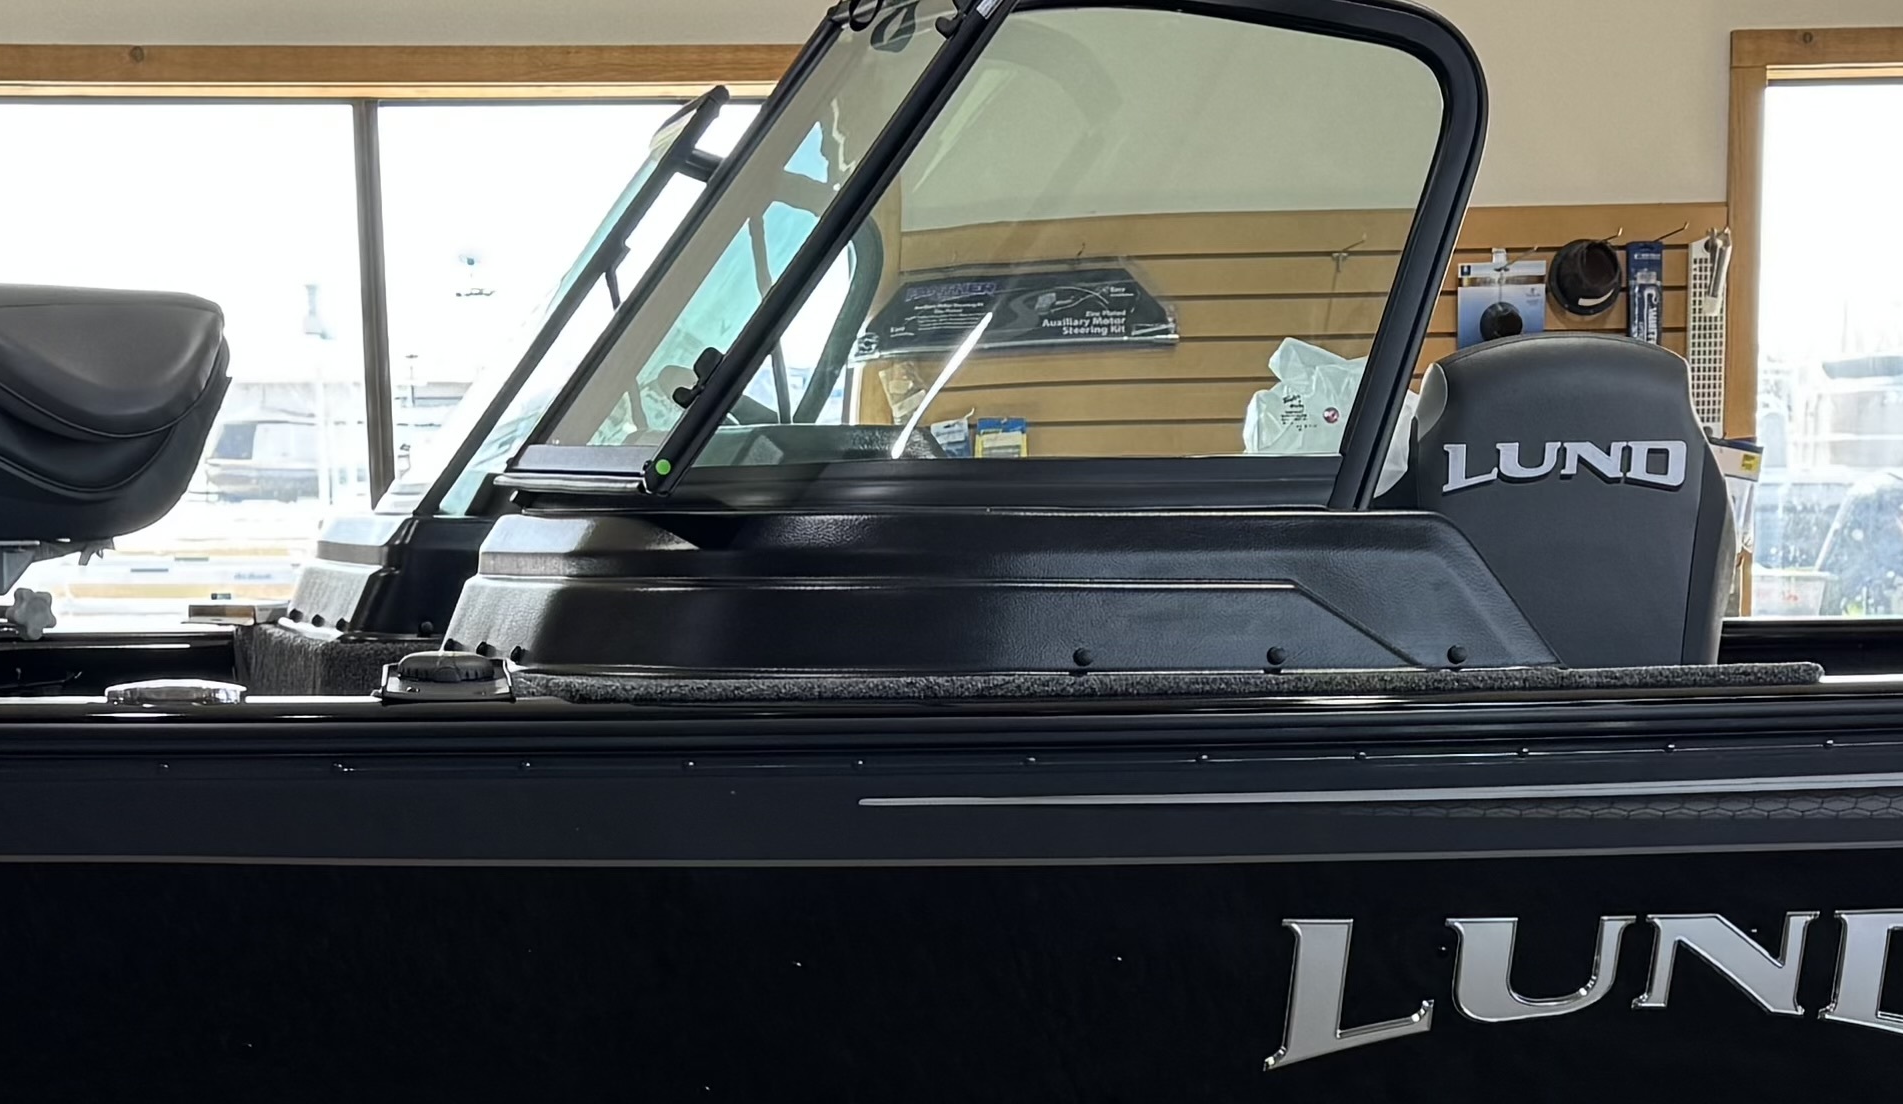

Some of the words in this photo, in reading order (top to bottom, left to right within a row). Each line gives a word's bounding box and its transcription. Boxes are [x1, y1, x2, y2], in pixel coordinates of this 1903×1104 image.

[1042, 317, 1090, 328] Auxiliary
[1092, 317, 1126, 326] Motor
[1062, 326, 1108, 336] Steering
[1110, 325, 1125, 333] Kit
[1442, 440, 1687, 493] LUND
